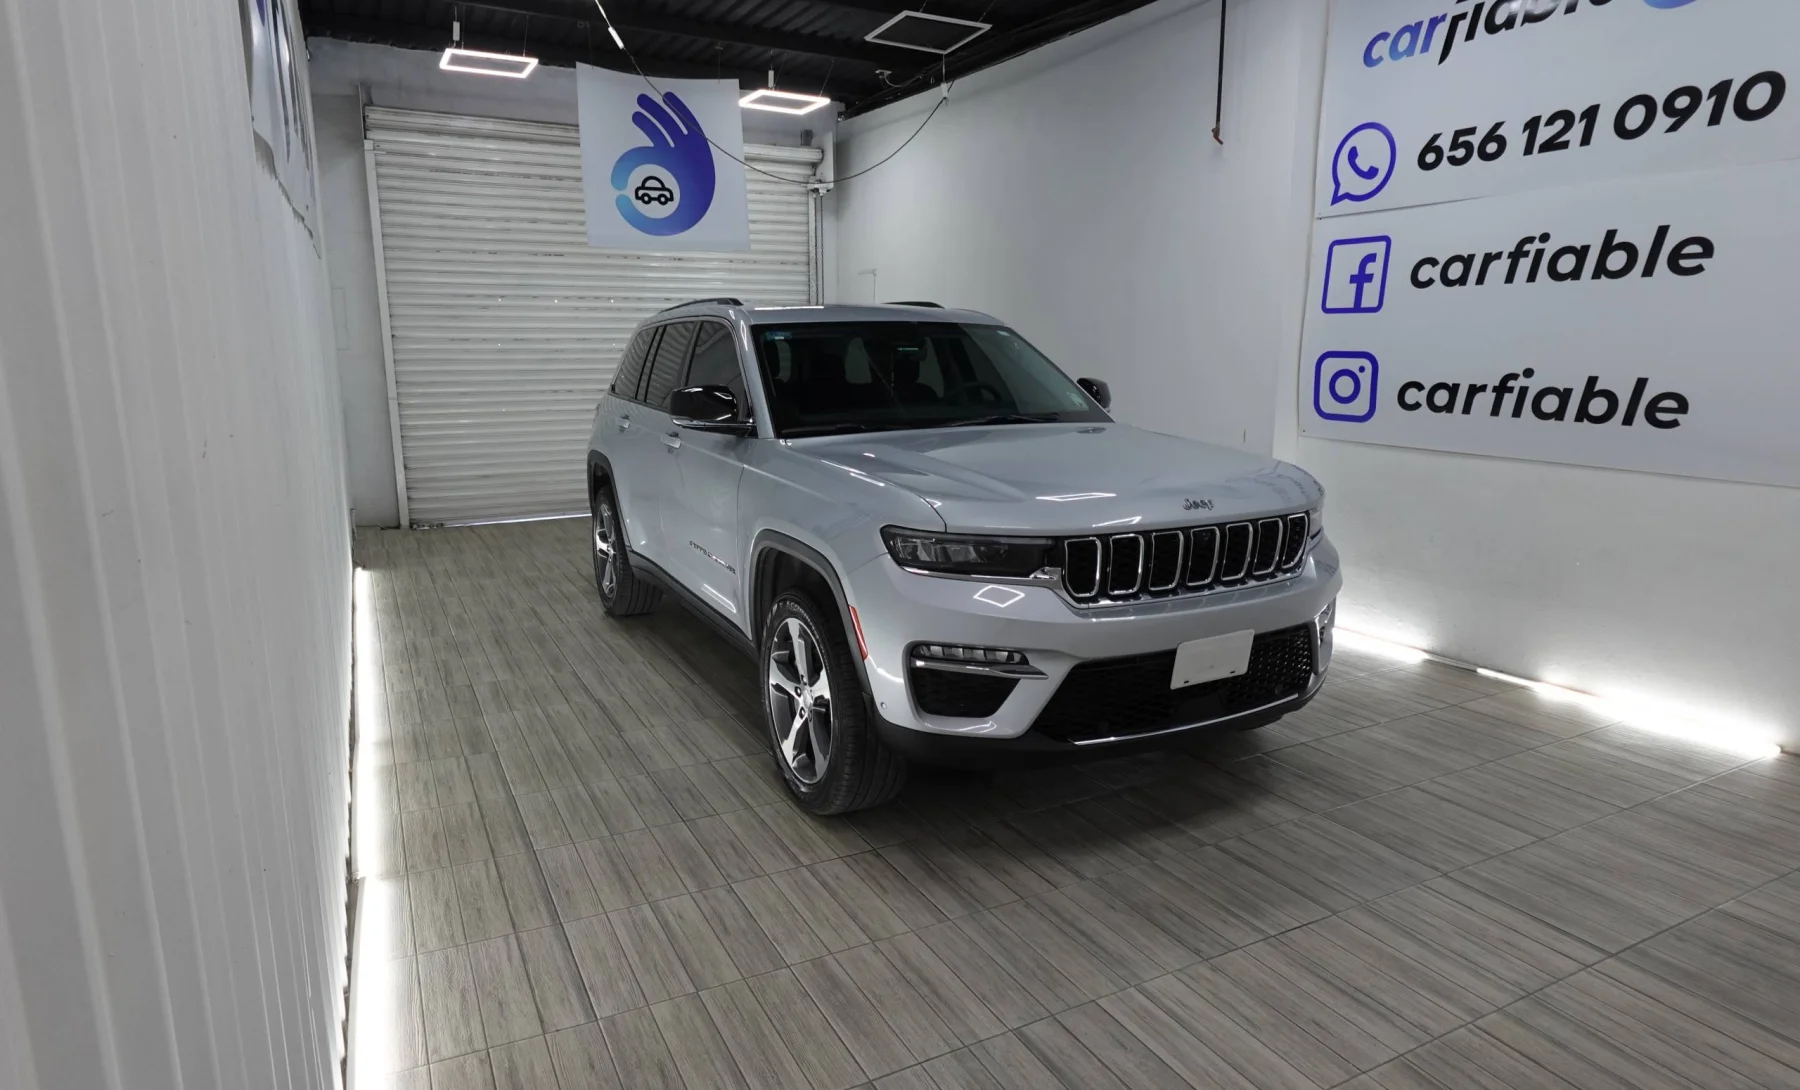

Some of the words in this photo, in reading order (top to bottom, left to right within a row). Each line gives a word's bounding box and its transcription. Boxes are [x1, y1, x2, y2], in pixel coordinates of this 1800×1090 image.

[1363, 0, 1612, 67] carfia
[1417, 121, 1507, 172] 656
[1521, 103, 1600, 157] 121
[1613, 70, 1787, 141] 0910
[1410, 225, 1715, 290] carfiable
[1397, 367, 1690, 430] carfiable
